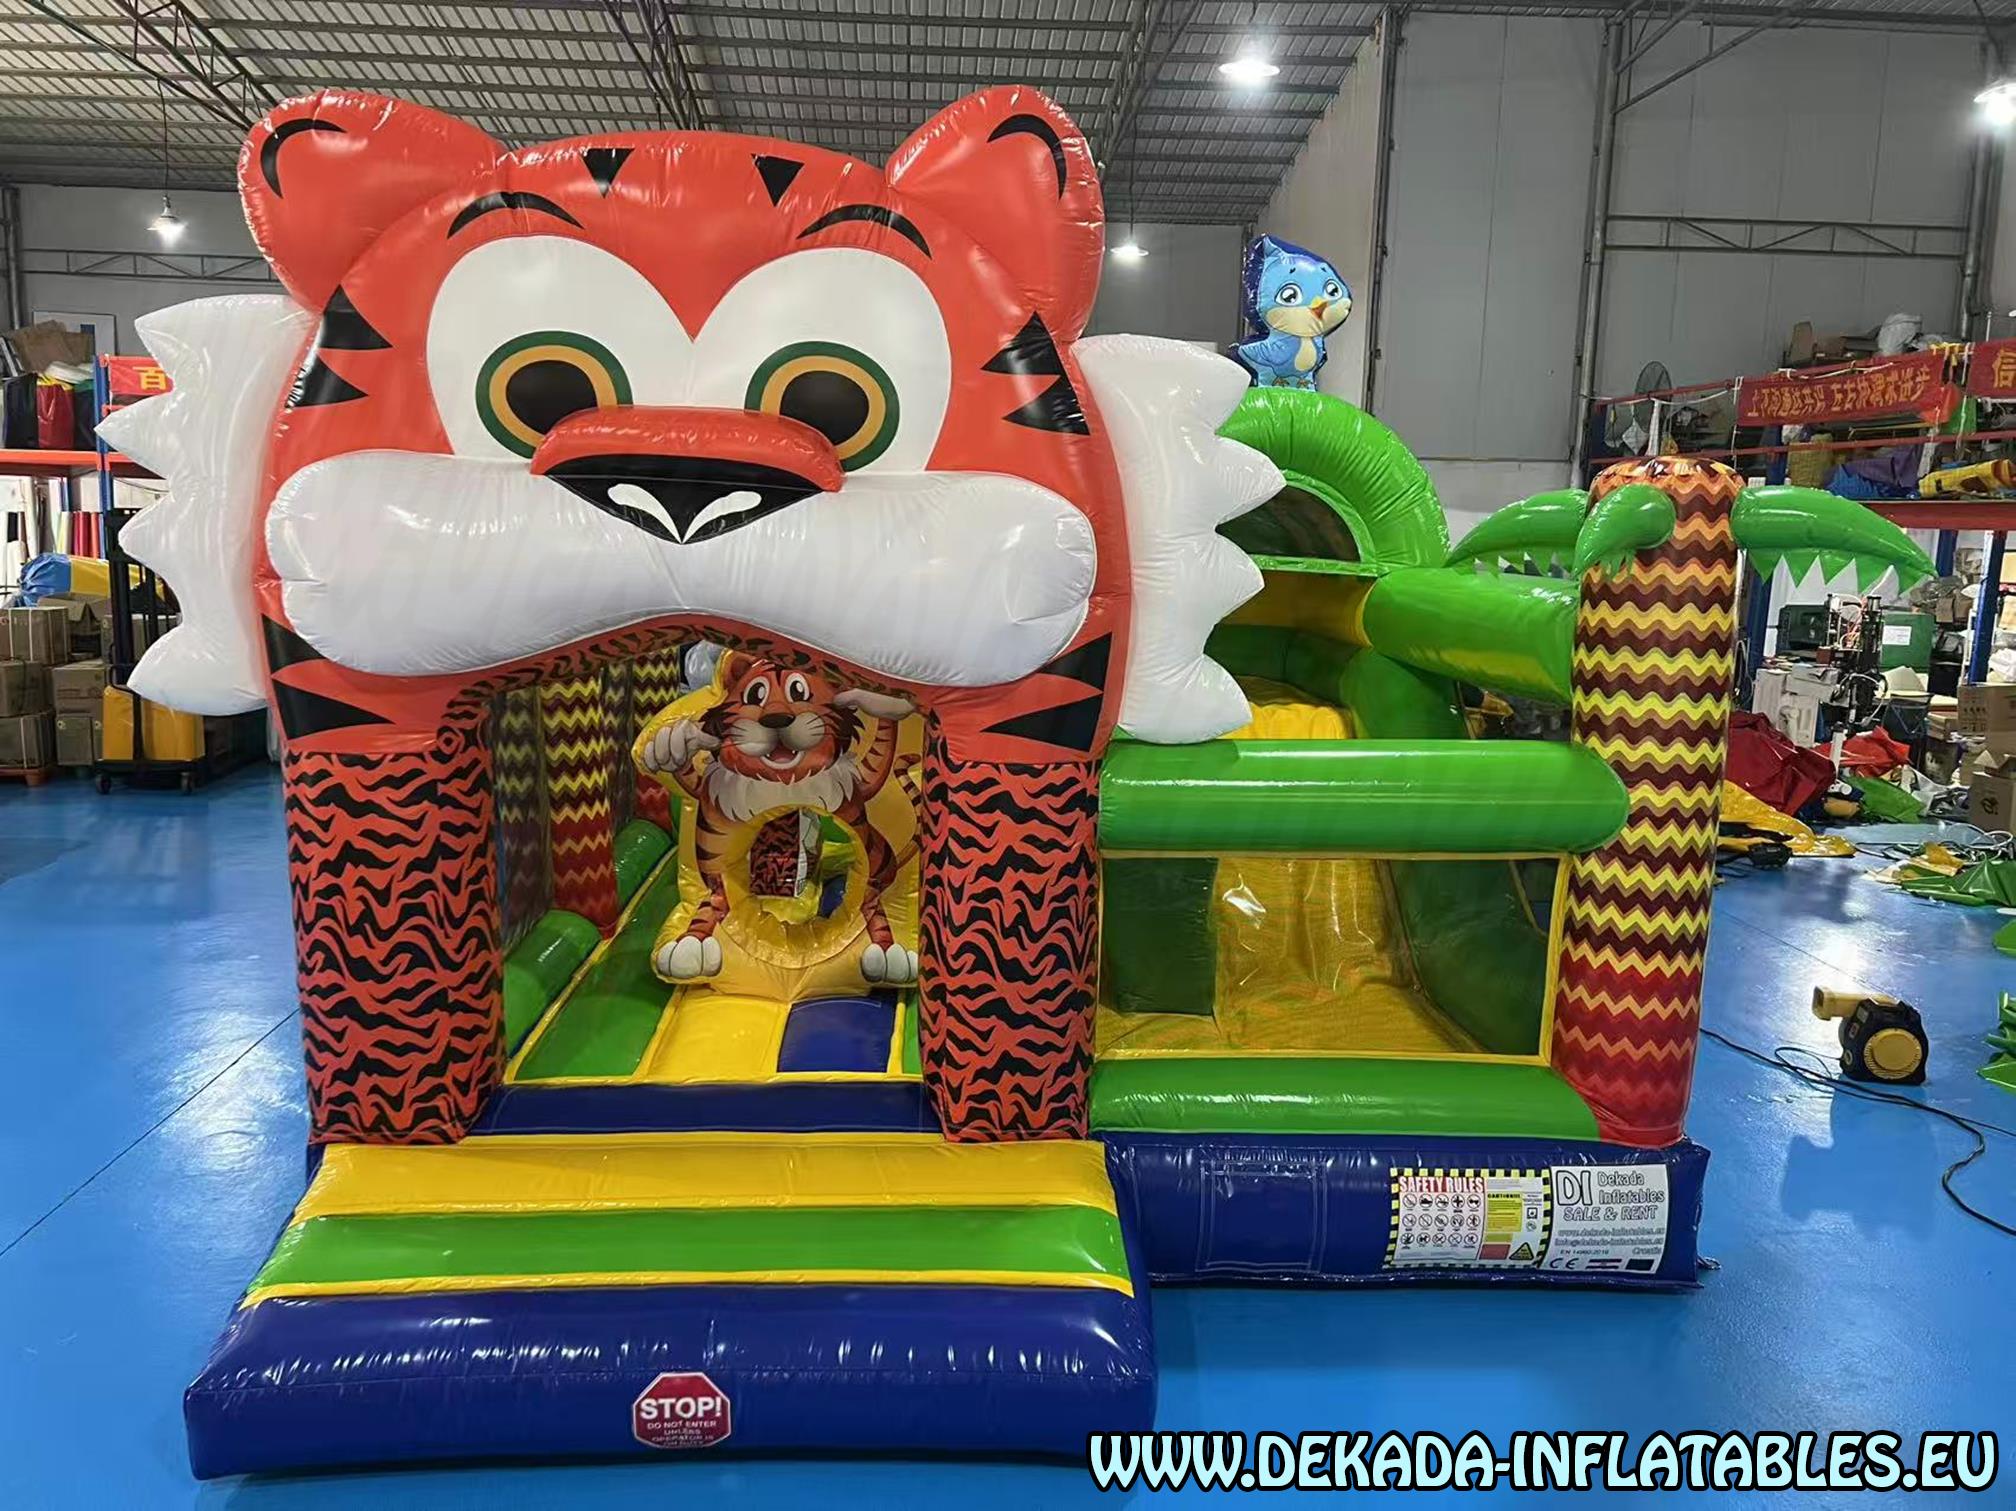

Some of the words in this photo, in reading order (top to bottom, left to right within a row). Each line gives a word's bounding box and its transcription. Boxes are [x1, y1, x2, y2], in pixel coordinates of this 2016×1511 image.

[1399, 1177, 1444, 1193] SAFETY
[1447, 1177, 1484, 1193] RULES
[1598, 1171, 1645, 1187] Dekada
[1556, 1170, 1593, 1206] DI
[1599, 1188, 1665, 1204] Inflatables
[1563, 1206, 1600, 1221] SALE
[1604, 1206, 1618, 1221] &
[1621, 1205, 1658, 1220] RENT
[640, 1397, 722, 1420] STOP!
[663, 1420, 683, 1429] NOT
[685, 1420, 717, 1428] ENTER
